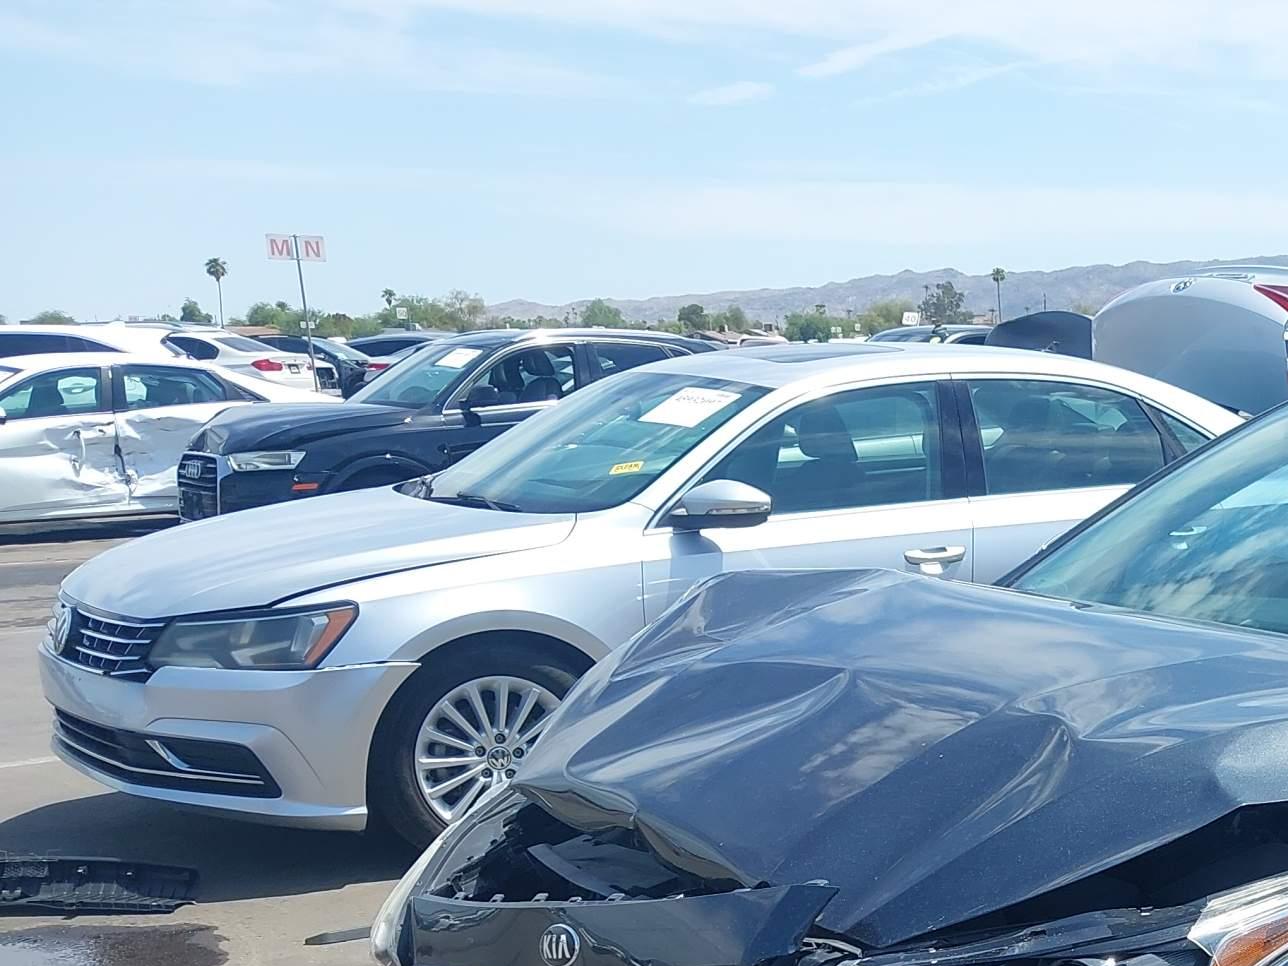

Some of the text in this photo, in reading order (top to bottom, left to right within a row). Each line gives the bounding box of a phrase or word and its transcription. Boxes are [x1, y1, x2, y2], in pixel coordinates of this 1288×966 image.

[270, 239, 291, 257] M
[304, 240, 321, 258] N
[543, 934, 571, 959] KIA
